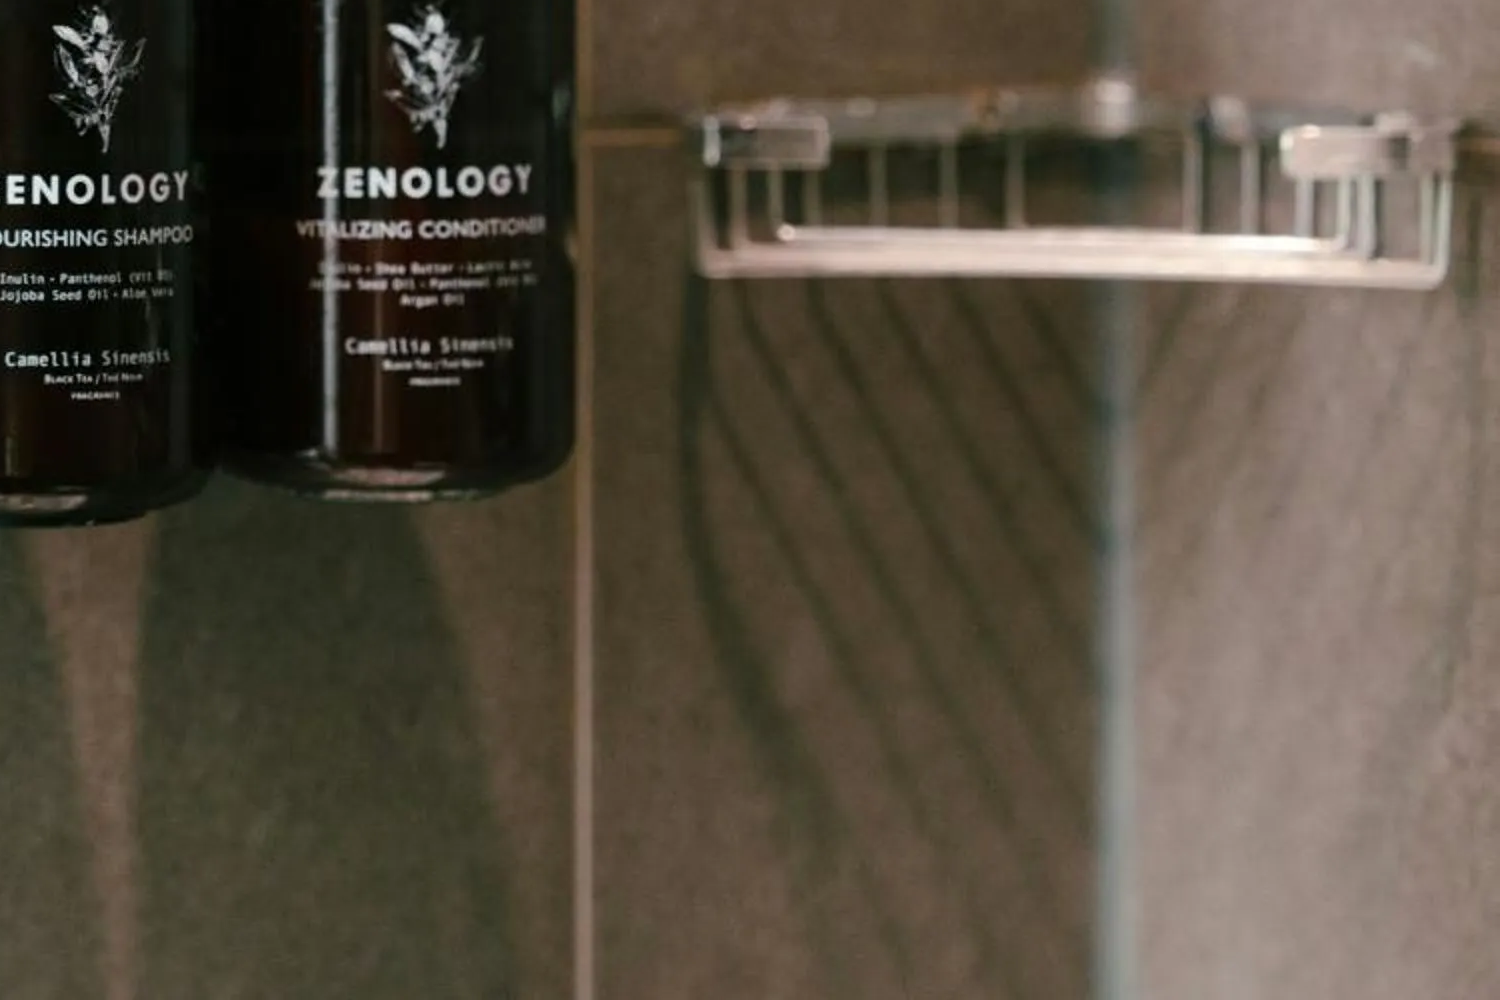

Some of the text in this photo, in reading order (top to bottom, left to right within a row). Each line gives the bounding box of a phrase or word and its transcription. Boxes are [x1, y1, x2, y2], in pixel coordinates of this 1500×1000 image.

[316, 163, 532, 199] ZENOLOGY
[113, 224, 194, 247] SHAMPOO
[296, 219, 413, 240] VITALIZING
[0, 289, 45, 304] Jojoba
[51, 289, 83, 302] Seed
[4, 348, 171, 368] Camellia Sinensis
